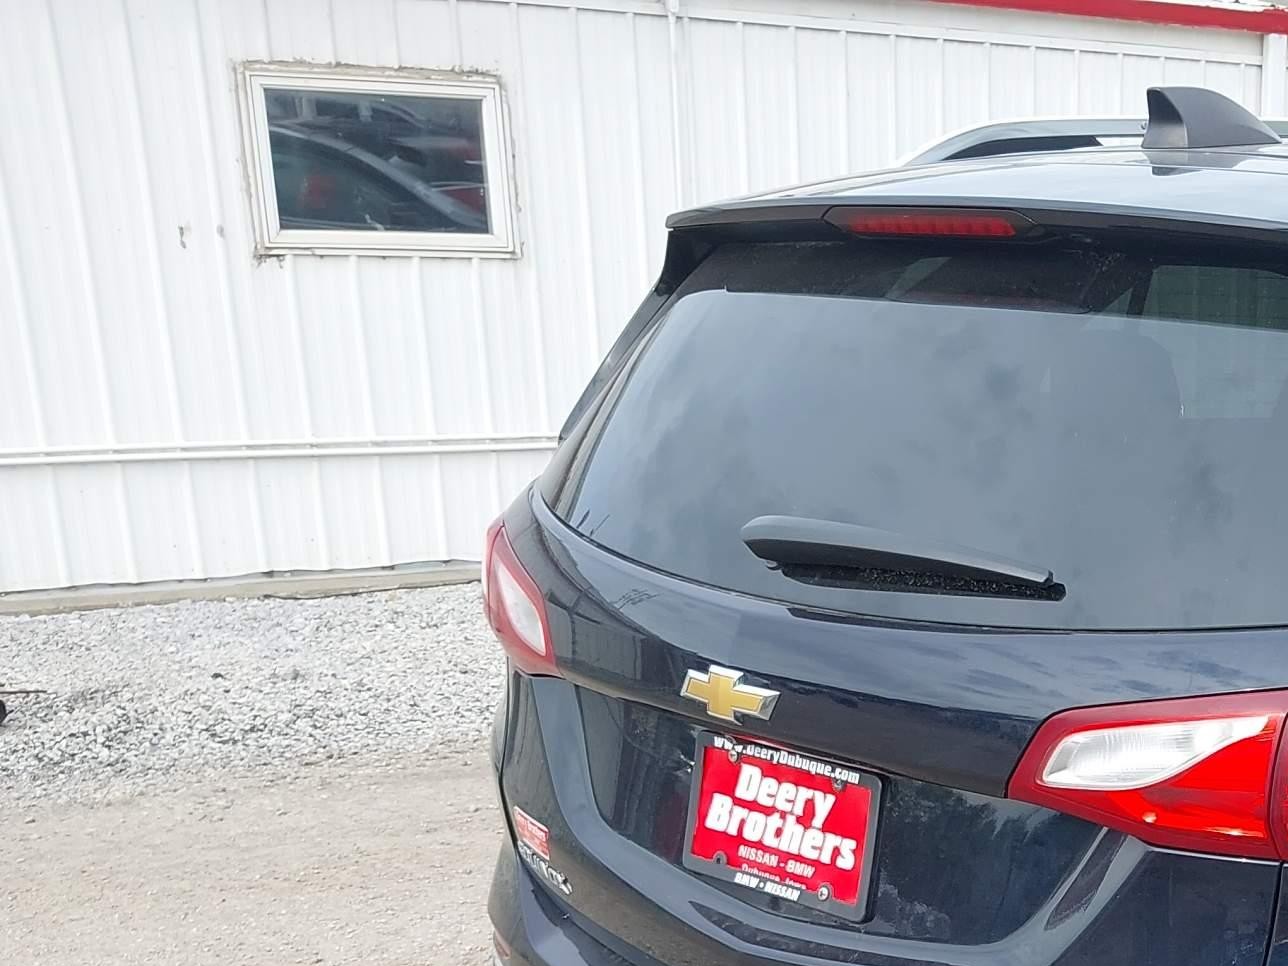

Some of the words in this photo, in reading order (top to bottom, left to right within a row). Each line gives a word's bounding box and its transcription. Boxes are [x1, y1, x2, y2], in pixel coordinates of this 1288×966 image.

[734, 763, 836, 829] Deery
[704, 792, 857, 871] Brothers
[737, 844, 780, 868] NISSAN
[785, 859, 816, 879] BMW
[734, 872, 760, 889] BMW
[763, 880, 801, 902] NISSAN
